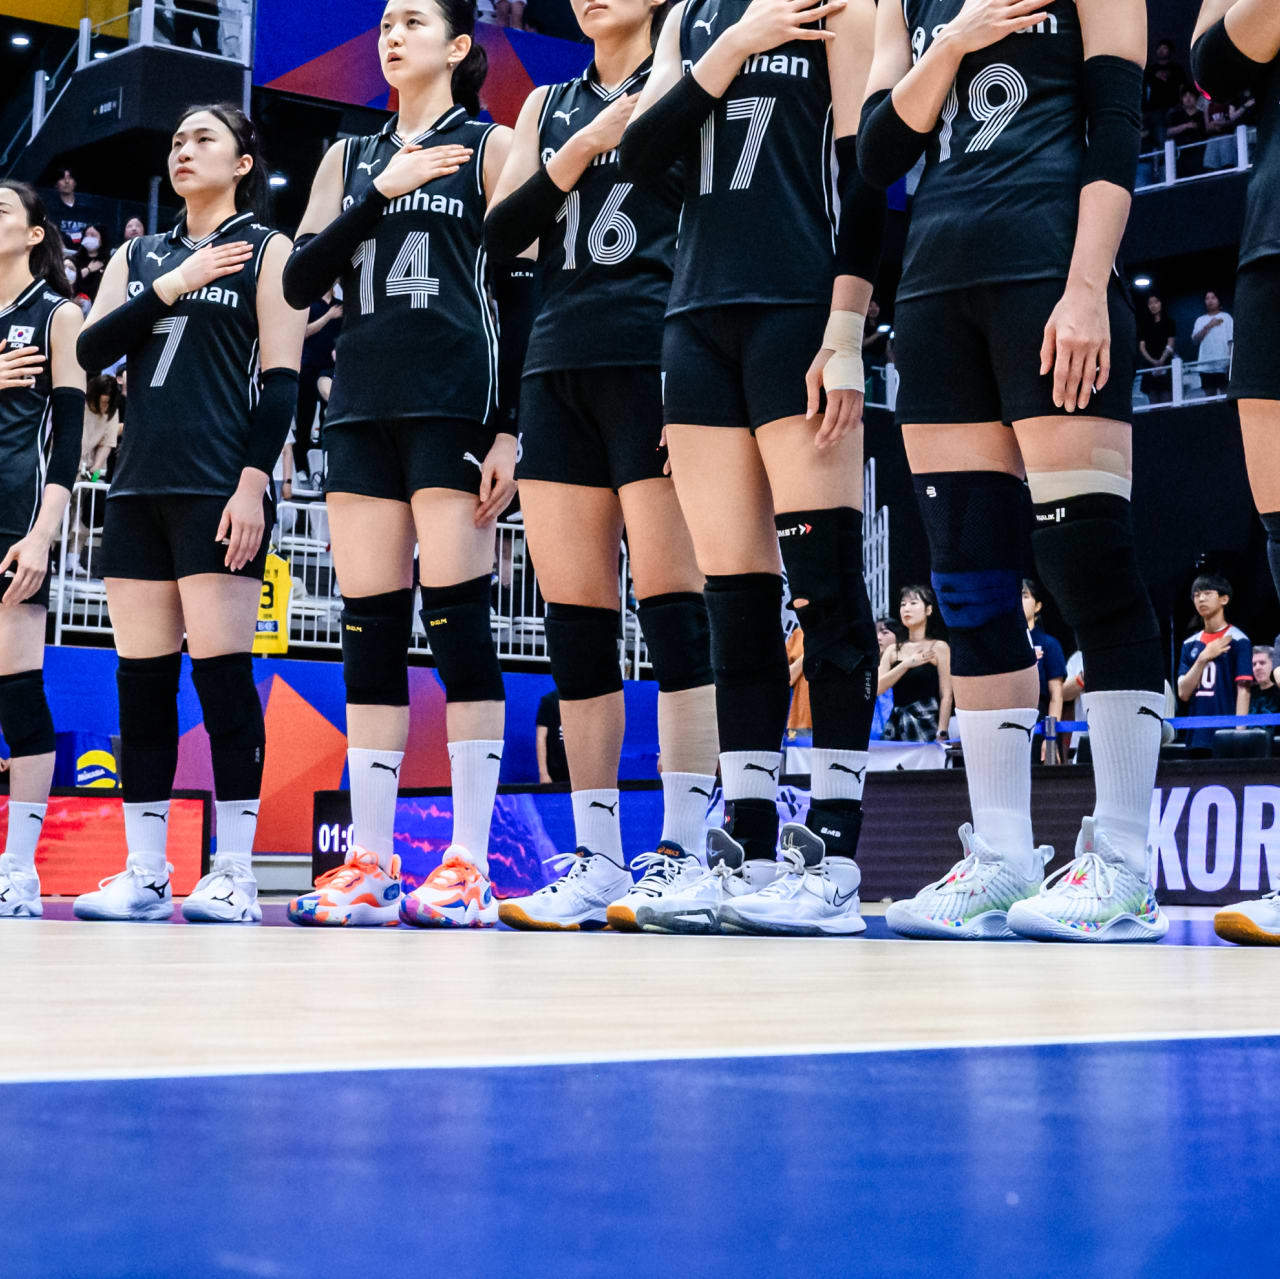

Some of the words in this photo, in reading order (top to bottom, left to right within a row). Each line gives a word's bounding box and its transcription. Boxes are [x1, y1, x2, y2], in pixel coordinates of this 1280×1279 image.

[699, 97, 776, 196] 17
[556, 182, 637, 271] 16
[351, 231, 439, 314] 14
[149, 316, 189, 388] 7
